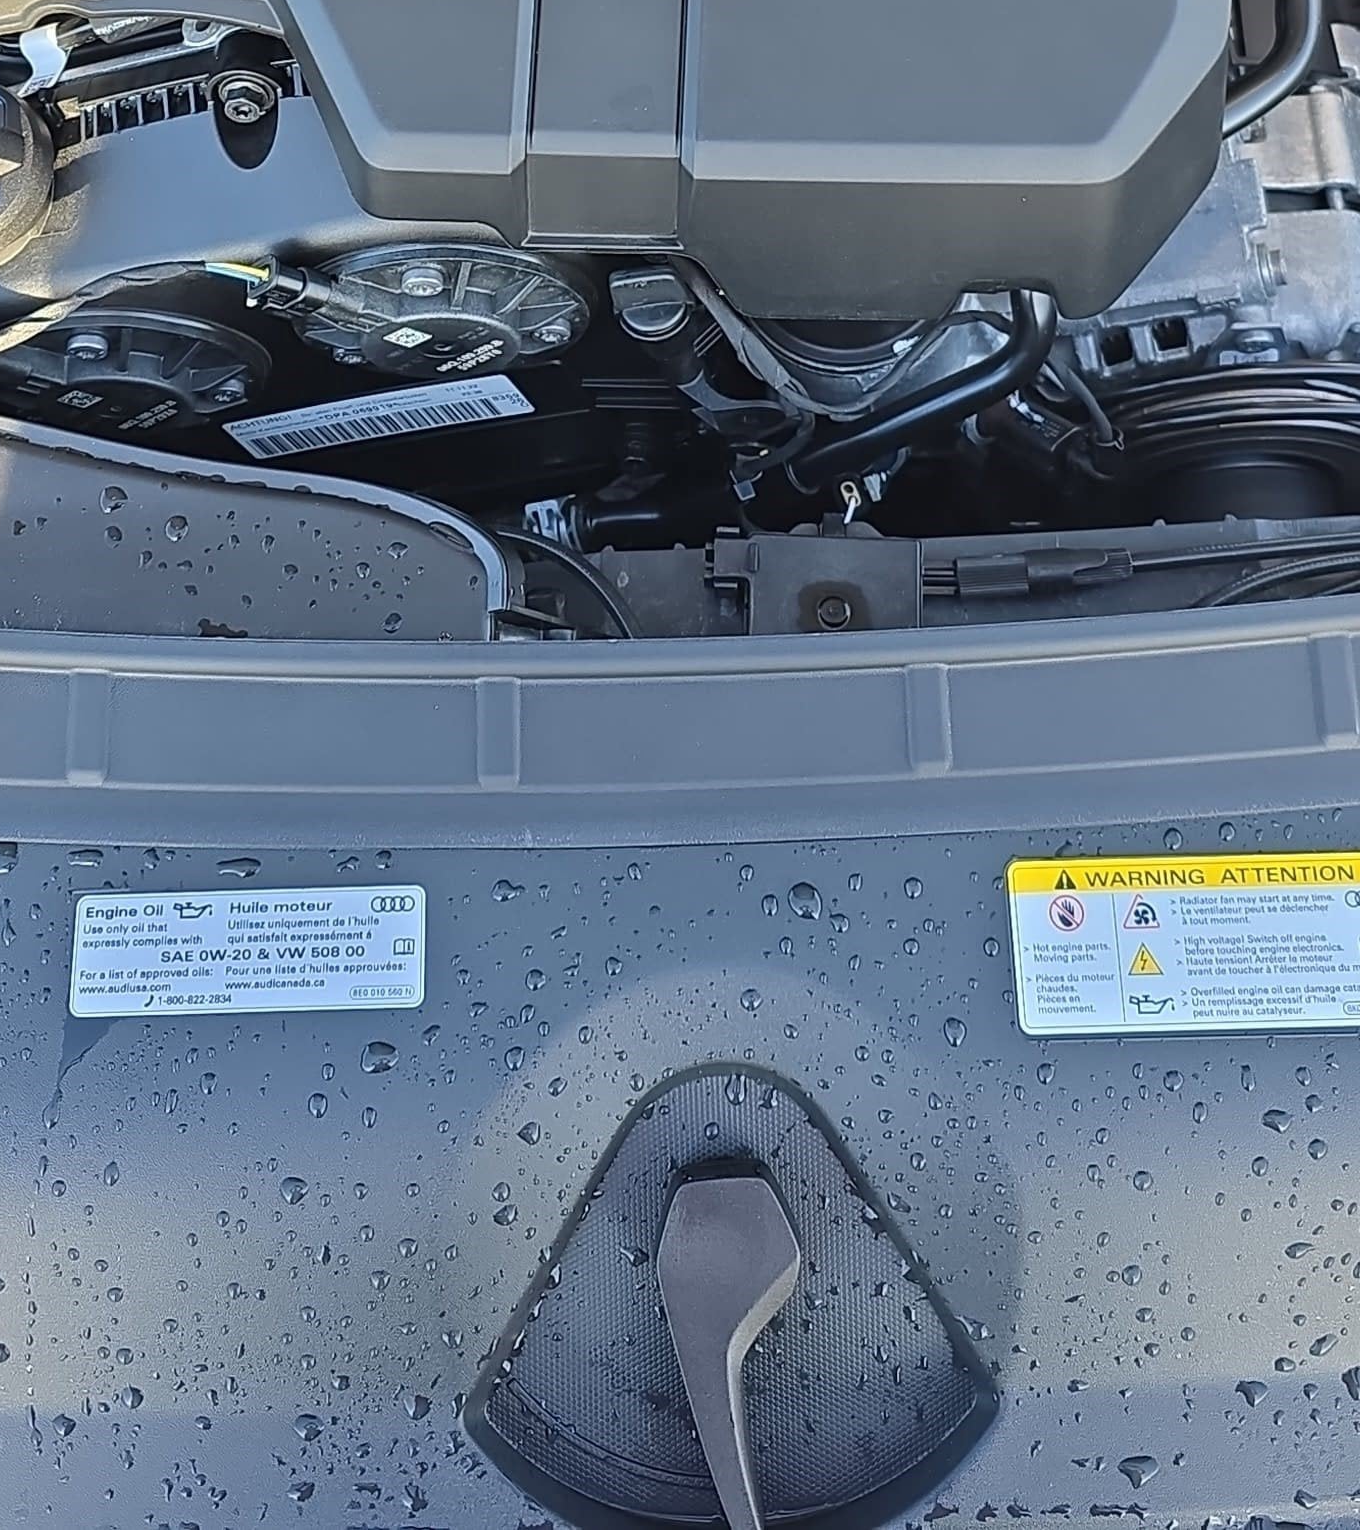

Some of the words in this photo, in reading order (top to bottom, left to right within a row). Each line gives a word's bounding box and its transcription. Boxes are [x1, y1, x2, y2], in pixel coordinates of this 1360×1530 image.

[1085, 869, 1205, 887] WARNING
[1220, 865, 1355, 883] ATTENTION
[1180, 896, 1217, 905] Radiator
[1220, 895, 1234, 904] fan
[1237, 896, 1257, 905] may
[1259, 894, 1279, 903] start
[1282, 895, 1290, 903] at
[1292, 895, 1309, 904] any
[1311, 894, 1334, 902] time.
[86, 906, 138, 920] Engine
[143, 904, 163, 916] Oil
[230, 902, 268, 914] Huile
[274, 901, 332, 912] moteur
[1181, 907, 1191, 915] Le
[1194, 905, 1241, 915] ventilateur
[1244, 905, 1264, 915] peut
[1267, 905, 1277, 913] se
[228, 919, 265, 930] Utilisez
[268, 917, 330, 930] uniquement
[333, 917, 345, 927] de
[1190, 916, 1208, 925] tout
[1210, 916, 1250, 924] moment.
[84, 924, 103, 934] Use
[106, 923, 128, 935] only
[131, 923, 144, 933] oil
[148, 922, 167, 932] that
[82, 937, 129, 949] expressly
[133, 936, 178, 948] complies
[181, 935, 202, 945] with
[228, 933, 244, 945] qui
[247, 932, 287, 943] satisfait
[1184, 936, 1205, 946] High
[1208, 935, 1244, 945] voltage!
[1247, 934, 1277, 944] Switch
[1280, 934, 1293, 943] off
[1295, 933, 1327, 944] engine
[161, 950, 194, 962] SAE
[200, 949, 251, 961] 0W-20
[257, 948, 269, 960] &
[276, 947, 305, 959] VW
[311, 946, 339, 958] 508
[346, 946, 365, 957] 00
[1033, 943, 1049, 953] Hot
[1052, 942, 1082, 953] engine
[1086, 942, 1111, 952] parts.
[1185, 946, 1214, 956] before
[1217, 945, 1256, 955] touching
[1260, 944, 1290, 954] engine
[1293, 943, 1344, 952] electronics.
[1034, 954, 1069, 963] Moving
[1072, 954, 1096, 963] parts.
[1186, 956, 1213, 966] Haute
[1289, 953, 1297, 963] le
[1300, 954, 1332, 963] moteur
[80, 970, 95, 980] For
[100, 972, 105, 980] a
[109, 969, 123, 979] list
[127, 968, 138, 979] of
[140, 967, 188, 980] approved
[192, 967, 213, 977] oils:
[226, 965, 249, 976] Pour
[253, 966, 271, 975] une
[275, 964, 296, 974] liste
[1187, 967, 1212, 976] avant
[1214, 966, 1226, 976] de
[1229, 965, 1263, 975] toucher
[1339, 962, 1350, 972] du
[225, 978, 325, 990] www.audicanada.ca
[1035, 973, 1064, 983] Pièces
[1067, 972, 1079, 982] du
[1082, 973, 1114, 982] moteur
[79, 983, 171, 994] www.audiusa.com
[1036, 984, 1077, 993] chaudes.
[1191, 987, 1235, 996] Overfilled
[1239, 986, 1269, 997] engine
[1271, 985, 1283, 995] oil
[1285, 986, 1301, 995] can
[1304, 984, 1340, 995] damage
[158, 994, 232, 1006] 1-800-822-2834
[1037, 994, 1066, 1004] Pièces
[1192, 997, 1205, 1007] Un
[1208, 996, 1263, 1009] remplissage
[1266, 995, 1302, 1005] excessif
[1038, 1005, 1096, 1014] mouvement.
[1193, 1008, 1213, 1019] peut
[1216, 1007, 1240, 1017] nuire
[1242, 1007, 1253, 1016] au
[1256, 1005, 1305, 1016] catalyseur.
